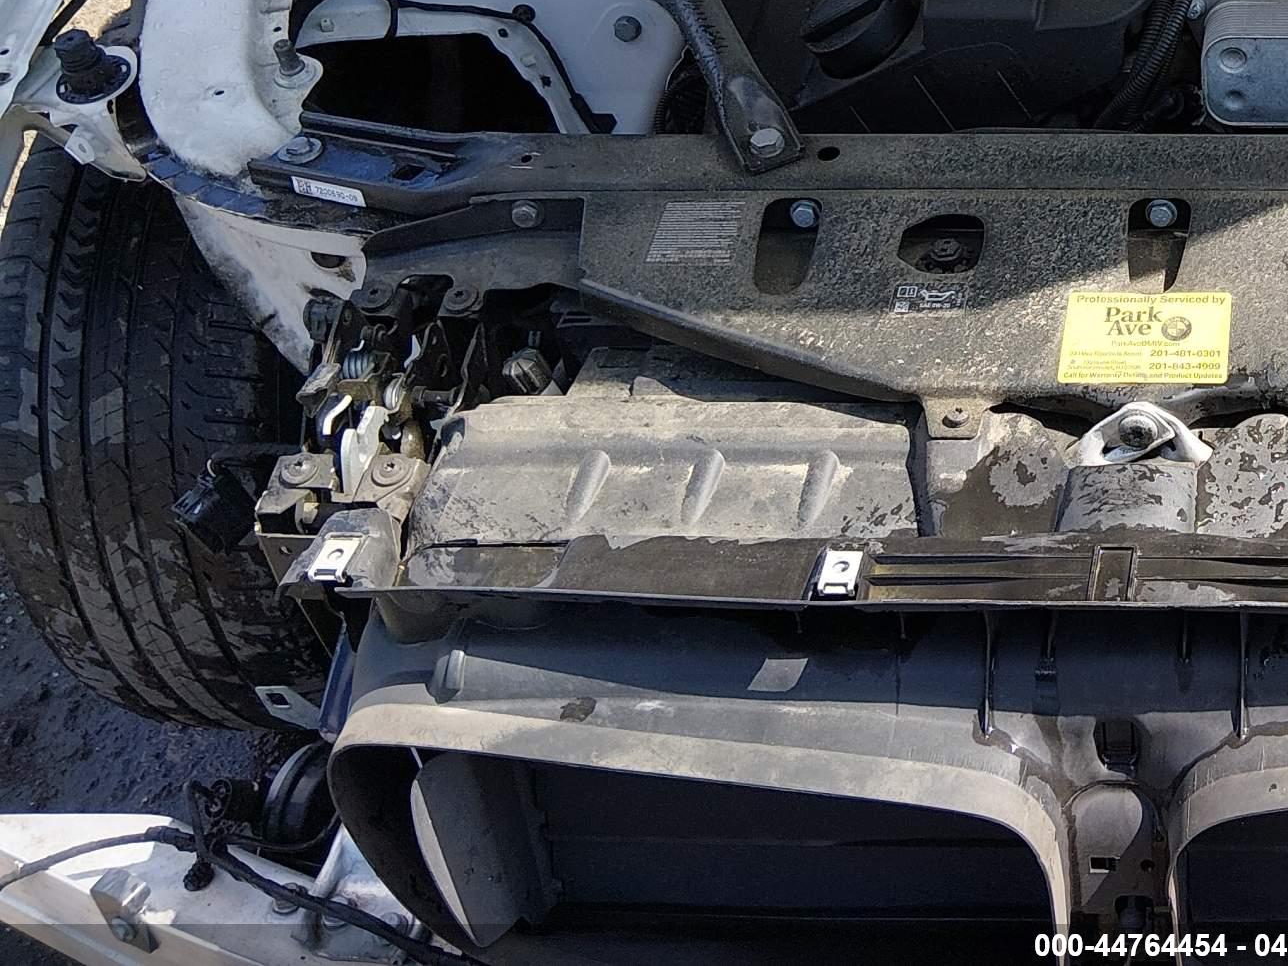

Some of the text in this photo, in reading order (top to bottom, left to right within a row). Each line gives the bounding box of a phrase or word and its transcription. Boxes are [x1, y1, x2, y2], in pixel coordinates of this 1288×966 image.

[1076, 295, 1226, 305] Professionally Serviced by
[1104, 306, 1164, 323] Park
[1106, 320, 1152, 336] Ave
[1089, 372, 1122, 380] Warranty
